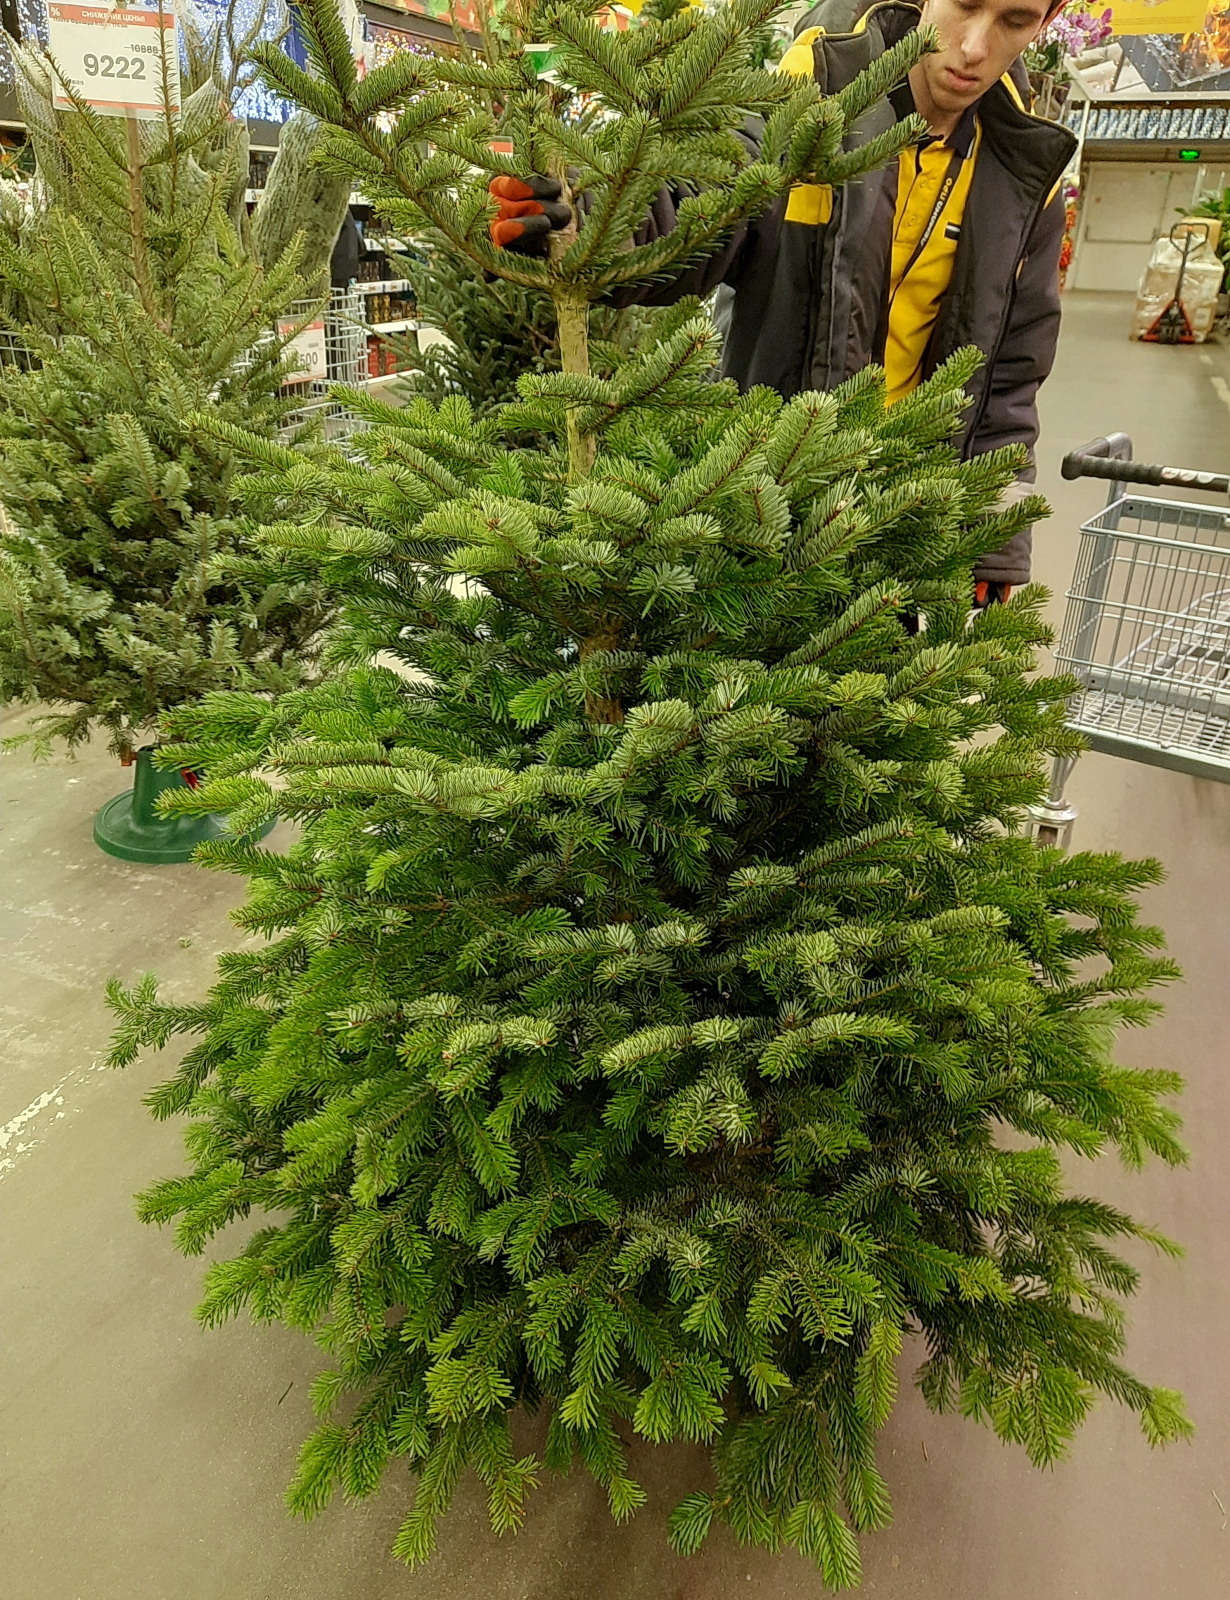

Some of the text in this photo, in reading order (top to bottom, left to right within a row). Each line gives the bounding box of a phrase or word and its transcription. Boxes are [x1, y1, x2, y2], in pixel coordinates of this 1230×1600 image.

[81, 10, 122, 20] СНИЖЕИЕ
[83, 53, 146, 80] 9222
[920, 177, 953, 247] ЛЕМАНА ПРО
[296, 351, 319, 366] 500
